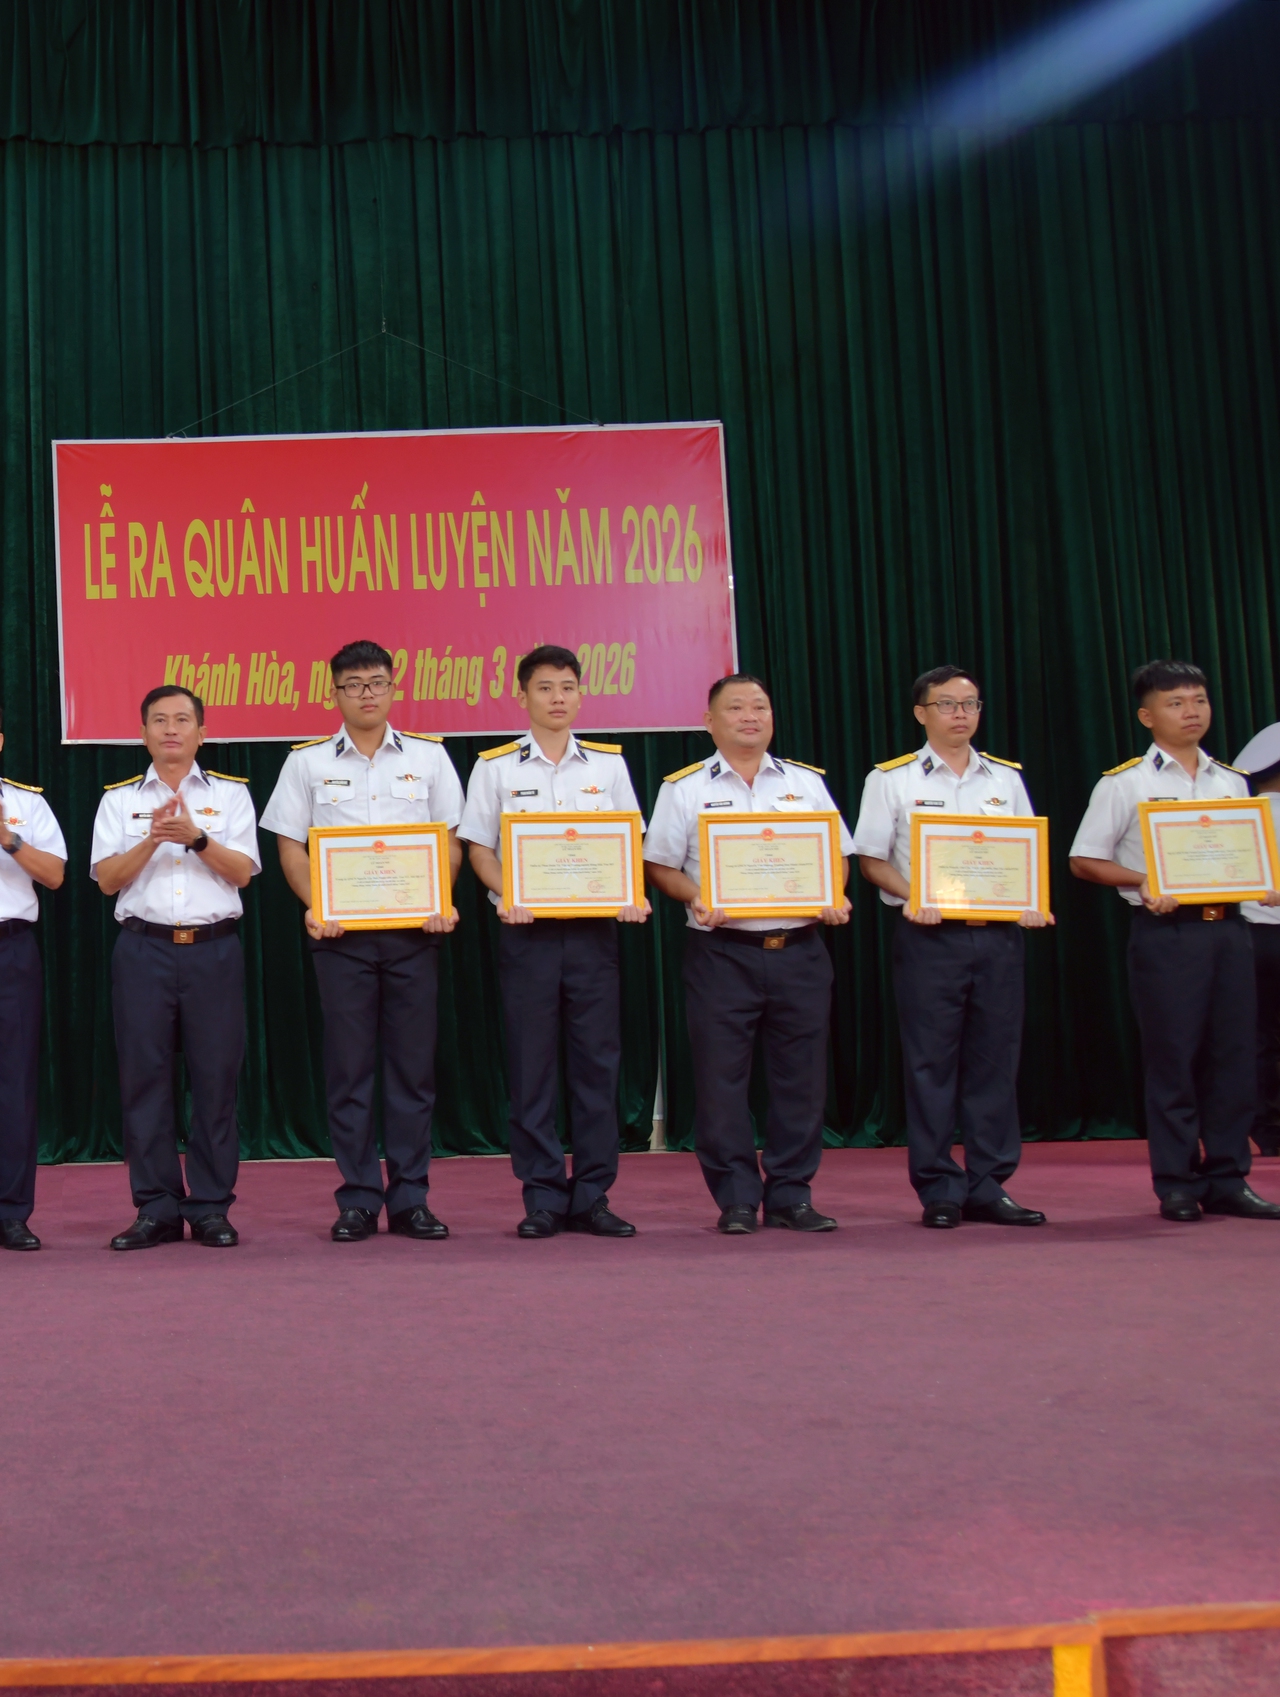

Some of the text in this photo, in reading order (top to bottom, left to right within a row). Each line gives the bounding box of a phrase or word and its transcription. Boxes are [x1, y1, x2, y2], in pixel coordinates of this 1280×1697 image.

[84, 481, 703, 608] LỄ RA QUÂN HUẤN LUYỆN NĂM 2026
[163, 652, 241, 706] Khánh
[245, 650, 300, 711] Hòa,
[385, 648, 408, 701] 2
[412, 645, 484, 706] tháng
[489, 645, 507, 699] 3
[577, 642, 637, 696] 2026
